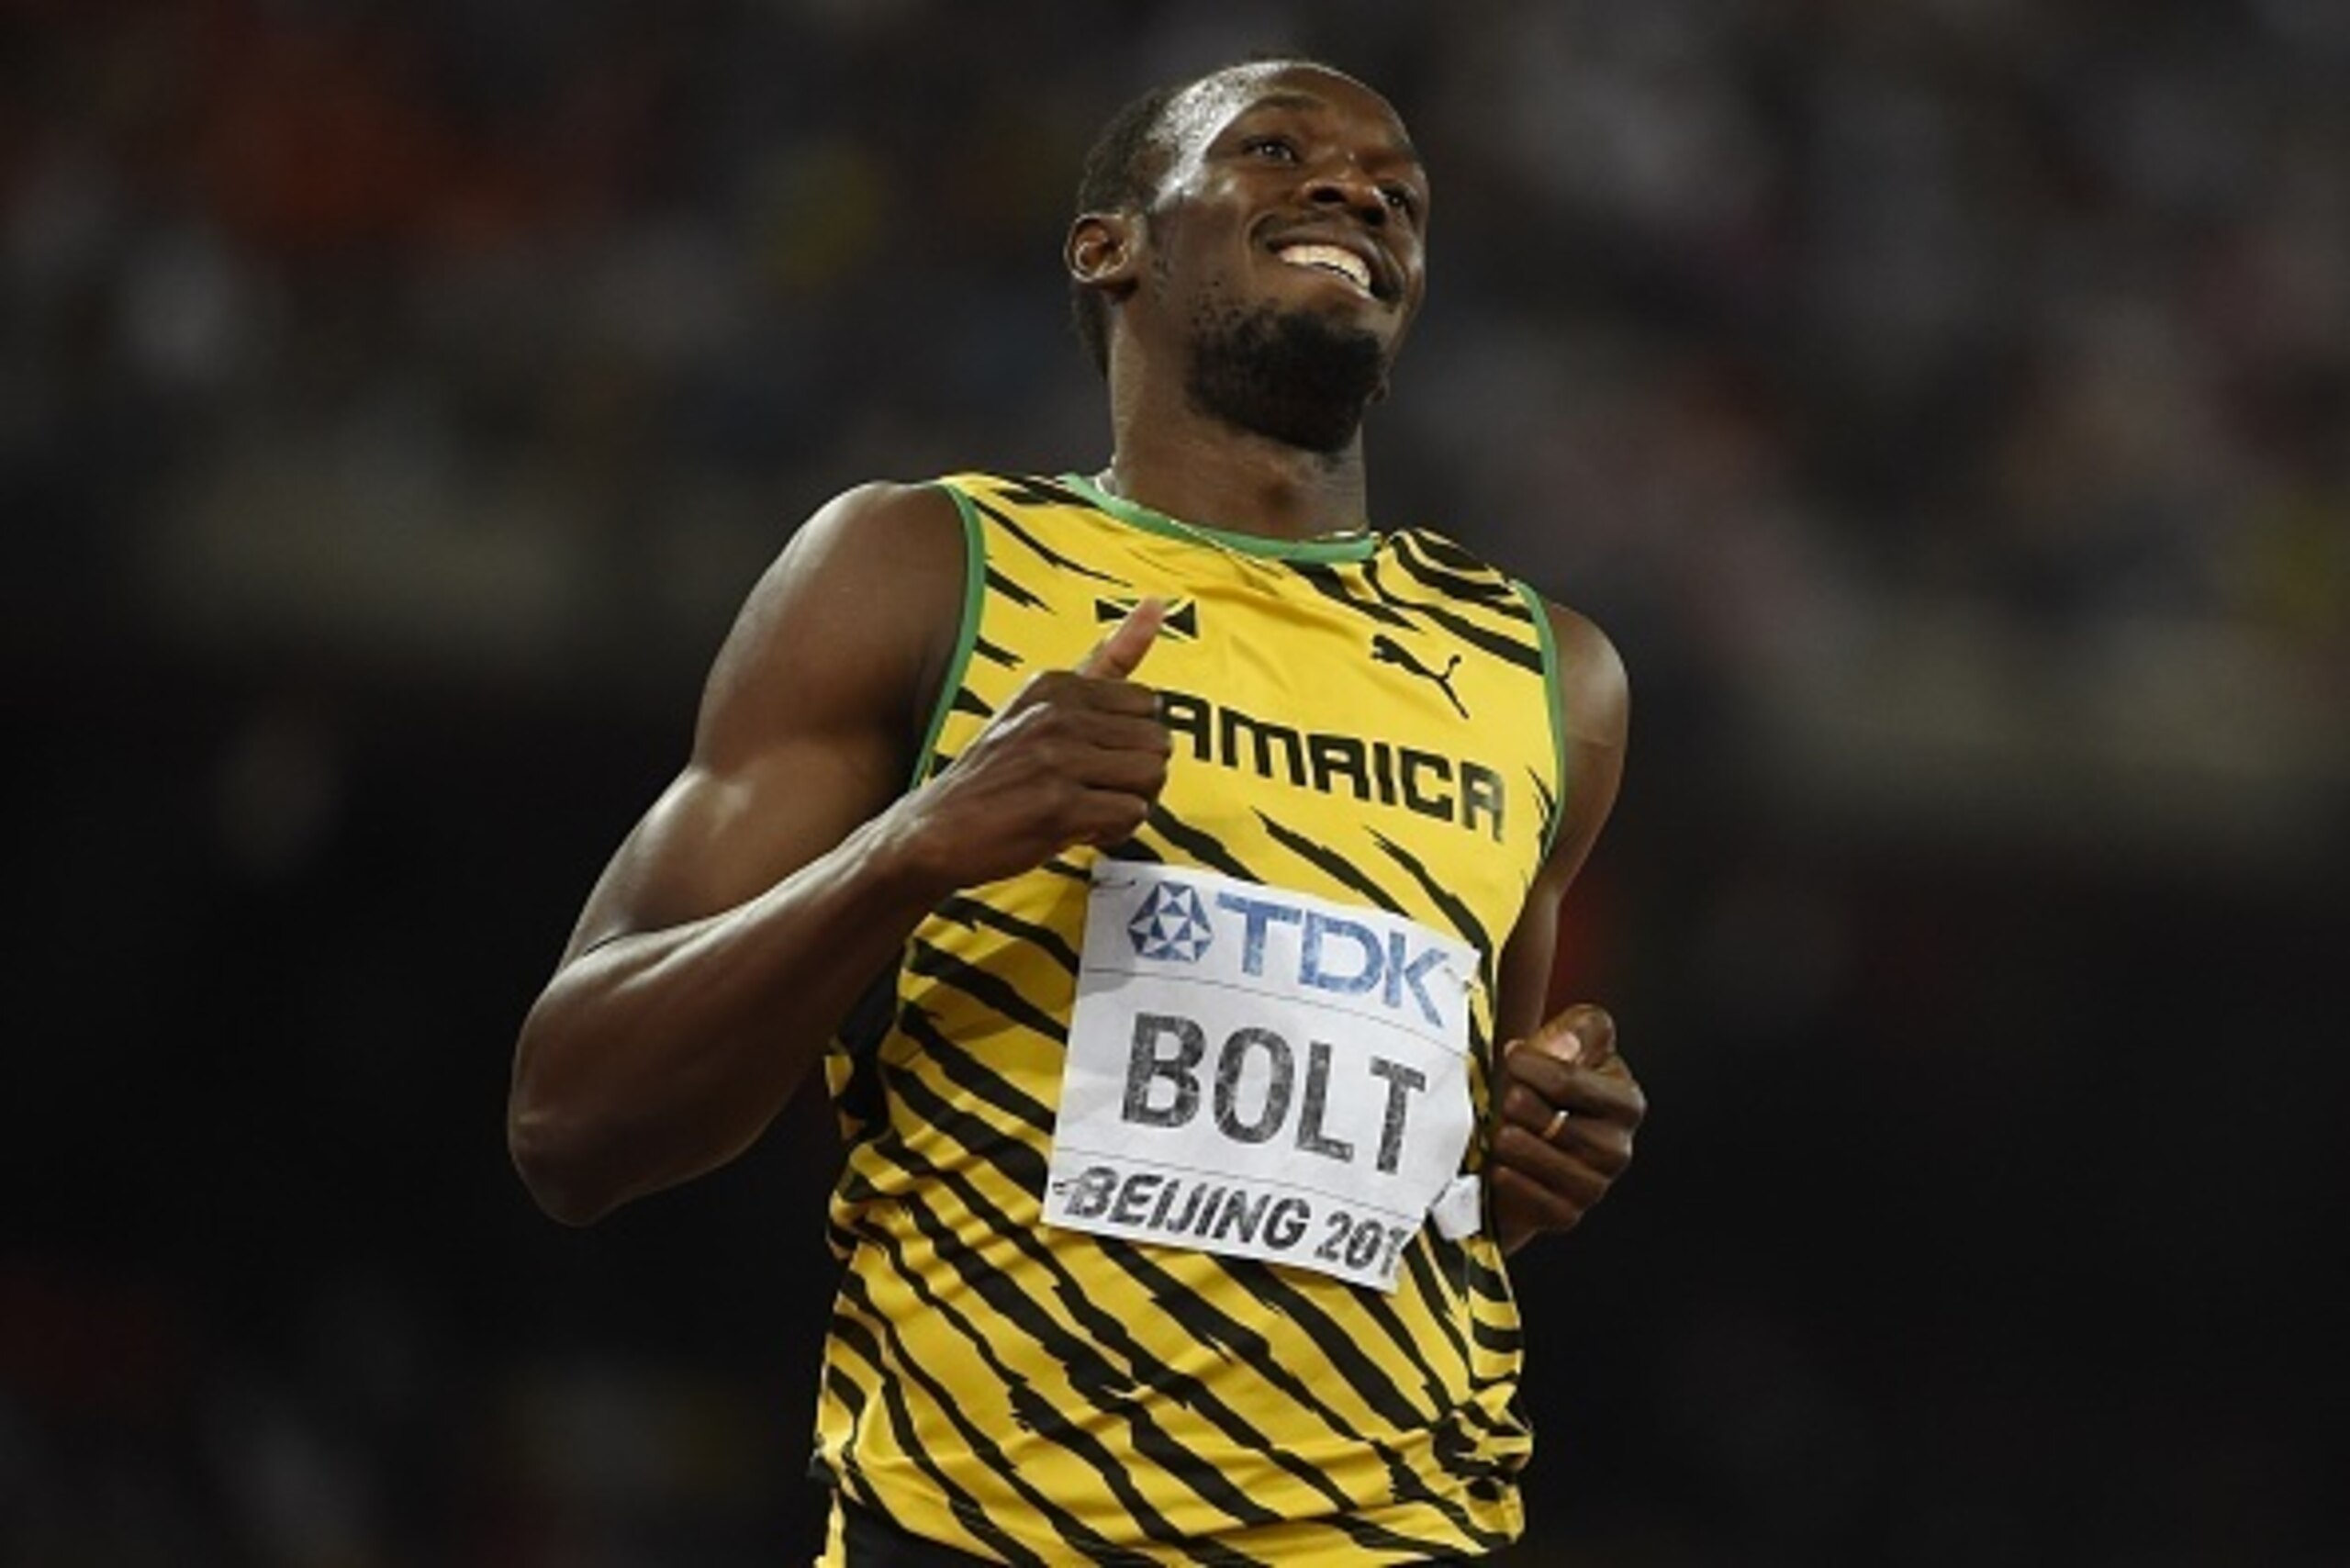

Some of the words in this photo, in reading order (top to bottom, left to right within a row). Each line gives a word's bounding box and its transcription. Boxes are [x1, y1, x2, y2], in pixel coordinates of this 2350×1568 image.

[1160, 690, 1504, 841] AMAICA
[1216, 893, 1449, 1028] TDK
[1122, 1014, 1427, 1174] BOLT
[1066, 1167, 1310, 1250] BEIJING
[1315, 1212, 1407, 1277] 201
